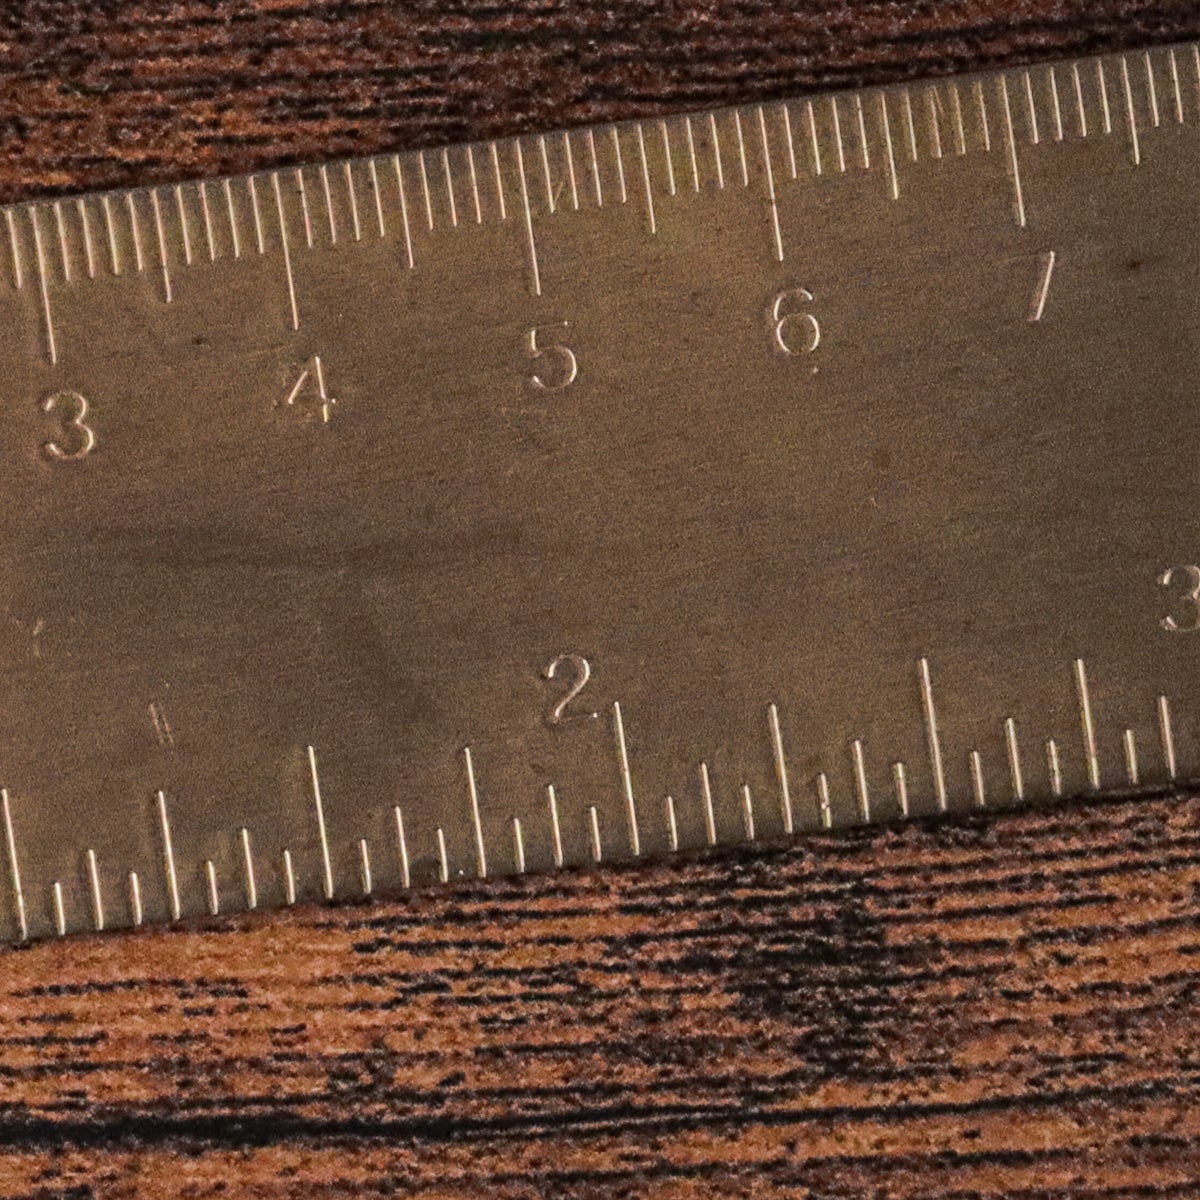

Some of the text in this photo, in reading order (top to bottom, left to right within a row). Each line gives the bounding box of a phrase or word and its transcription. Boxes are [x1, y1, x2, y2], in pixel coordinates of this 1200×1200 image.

[43, 391, 95, 460] 3
[285, 354, 338, 423] 4
[528, 320, 578, 391] 5
[772, 287, 822, 357] 6
[545, 652, 599, 725] 2
[1159, 565, 1200, 633] 3
